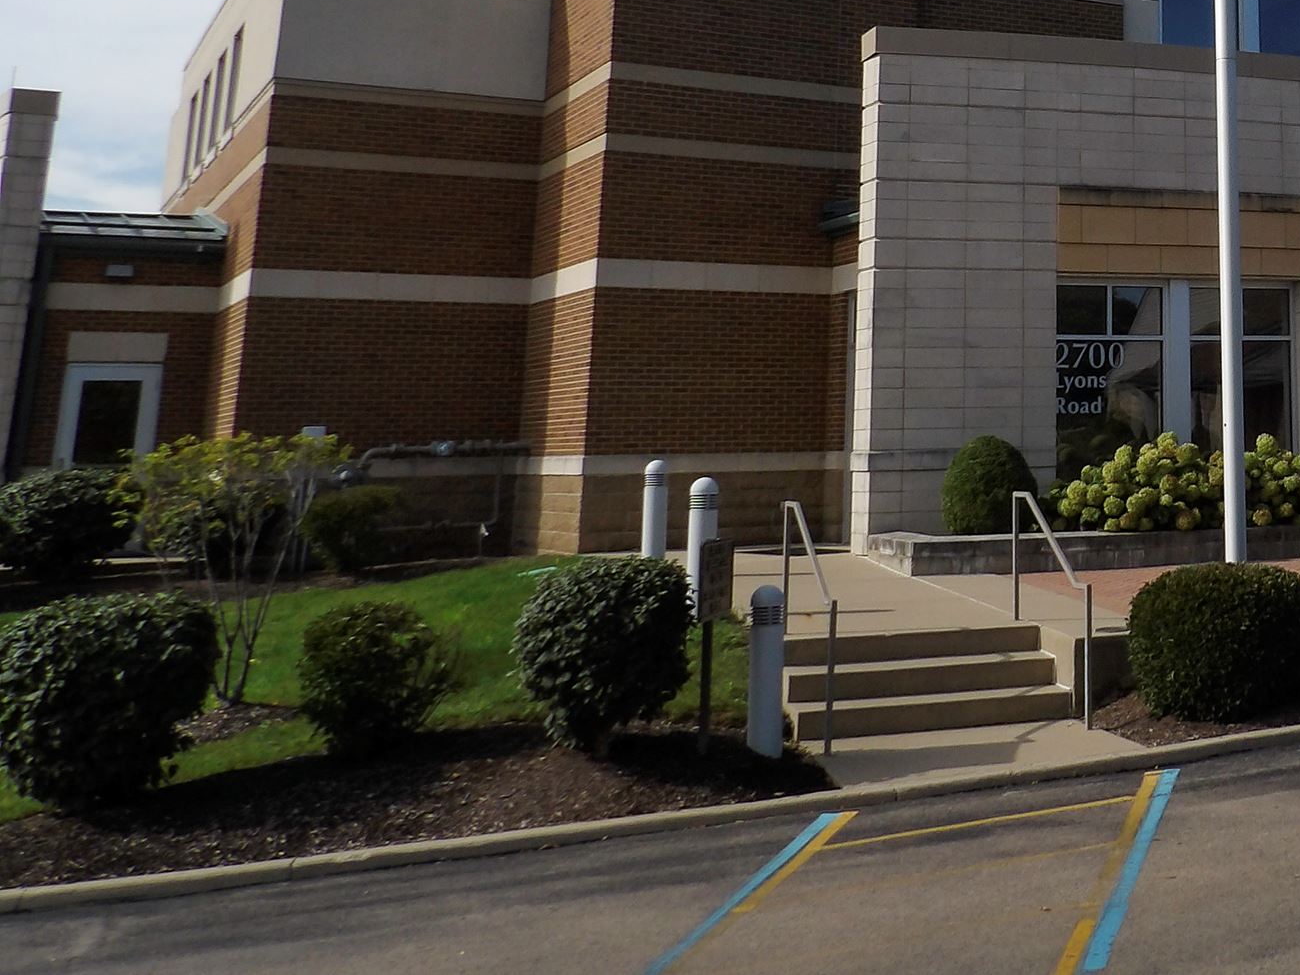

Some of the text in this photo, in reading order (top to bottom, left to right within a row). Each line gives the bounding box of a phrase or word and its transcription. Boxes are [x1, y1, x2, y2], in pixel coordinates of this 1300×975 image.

[1056, 342, 1124, 369] 2700
[1056, 372, 1107, 394] Lyons
[1056, 396, 1102, 414] Road
